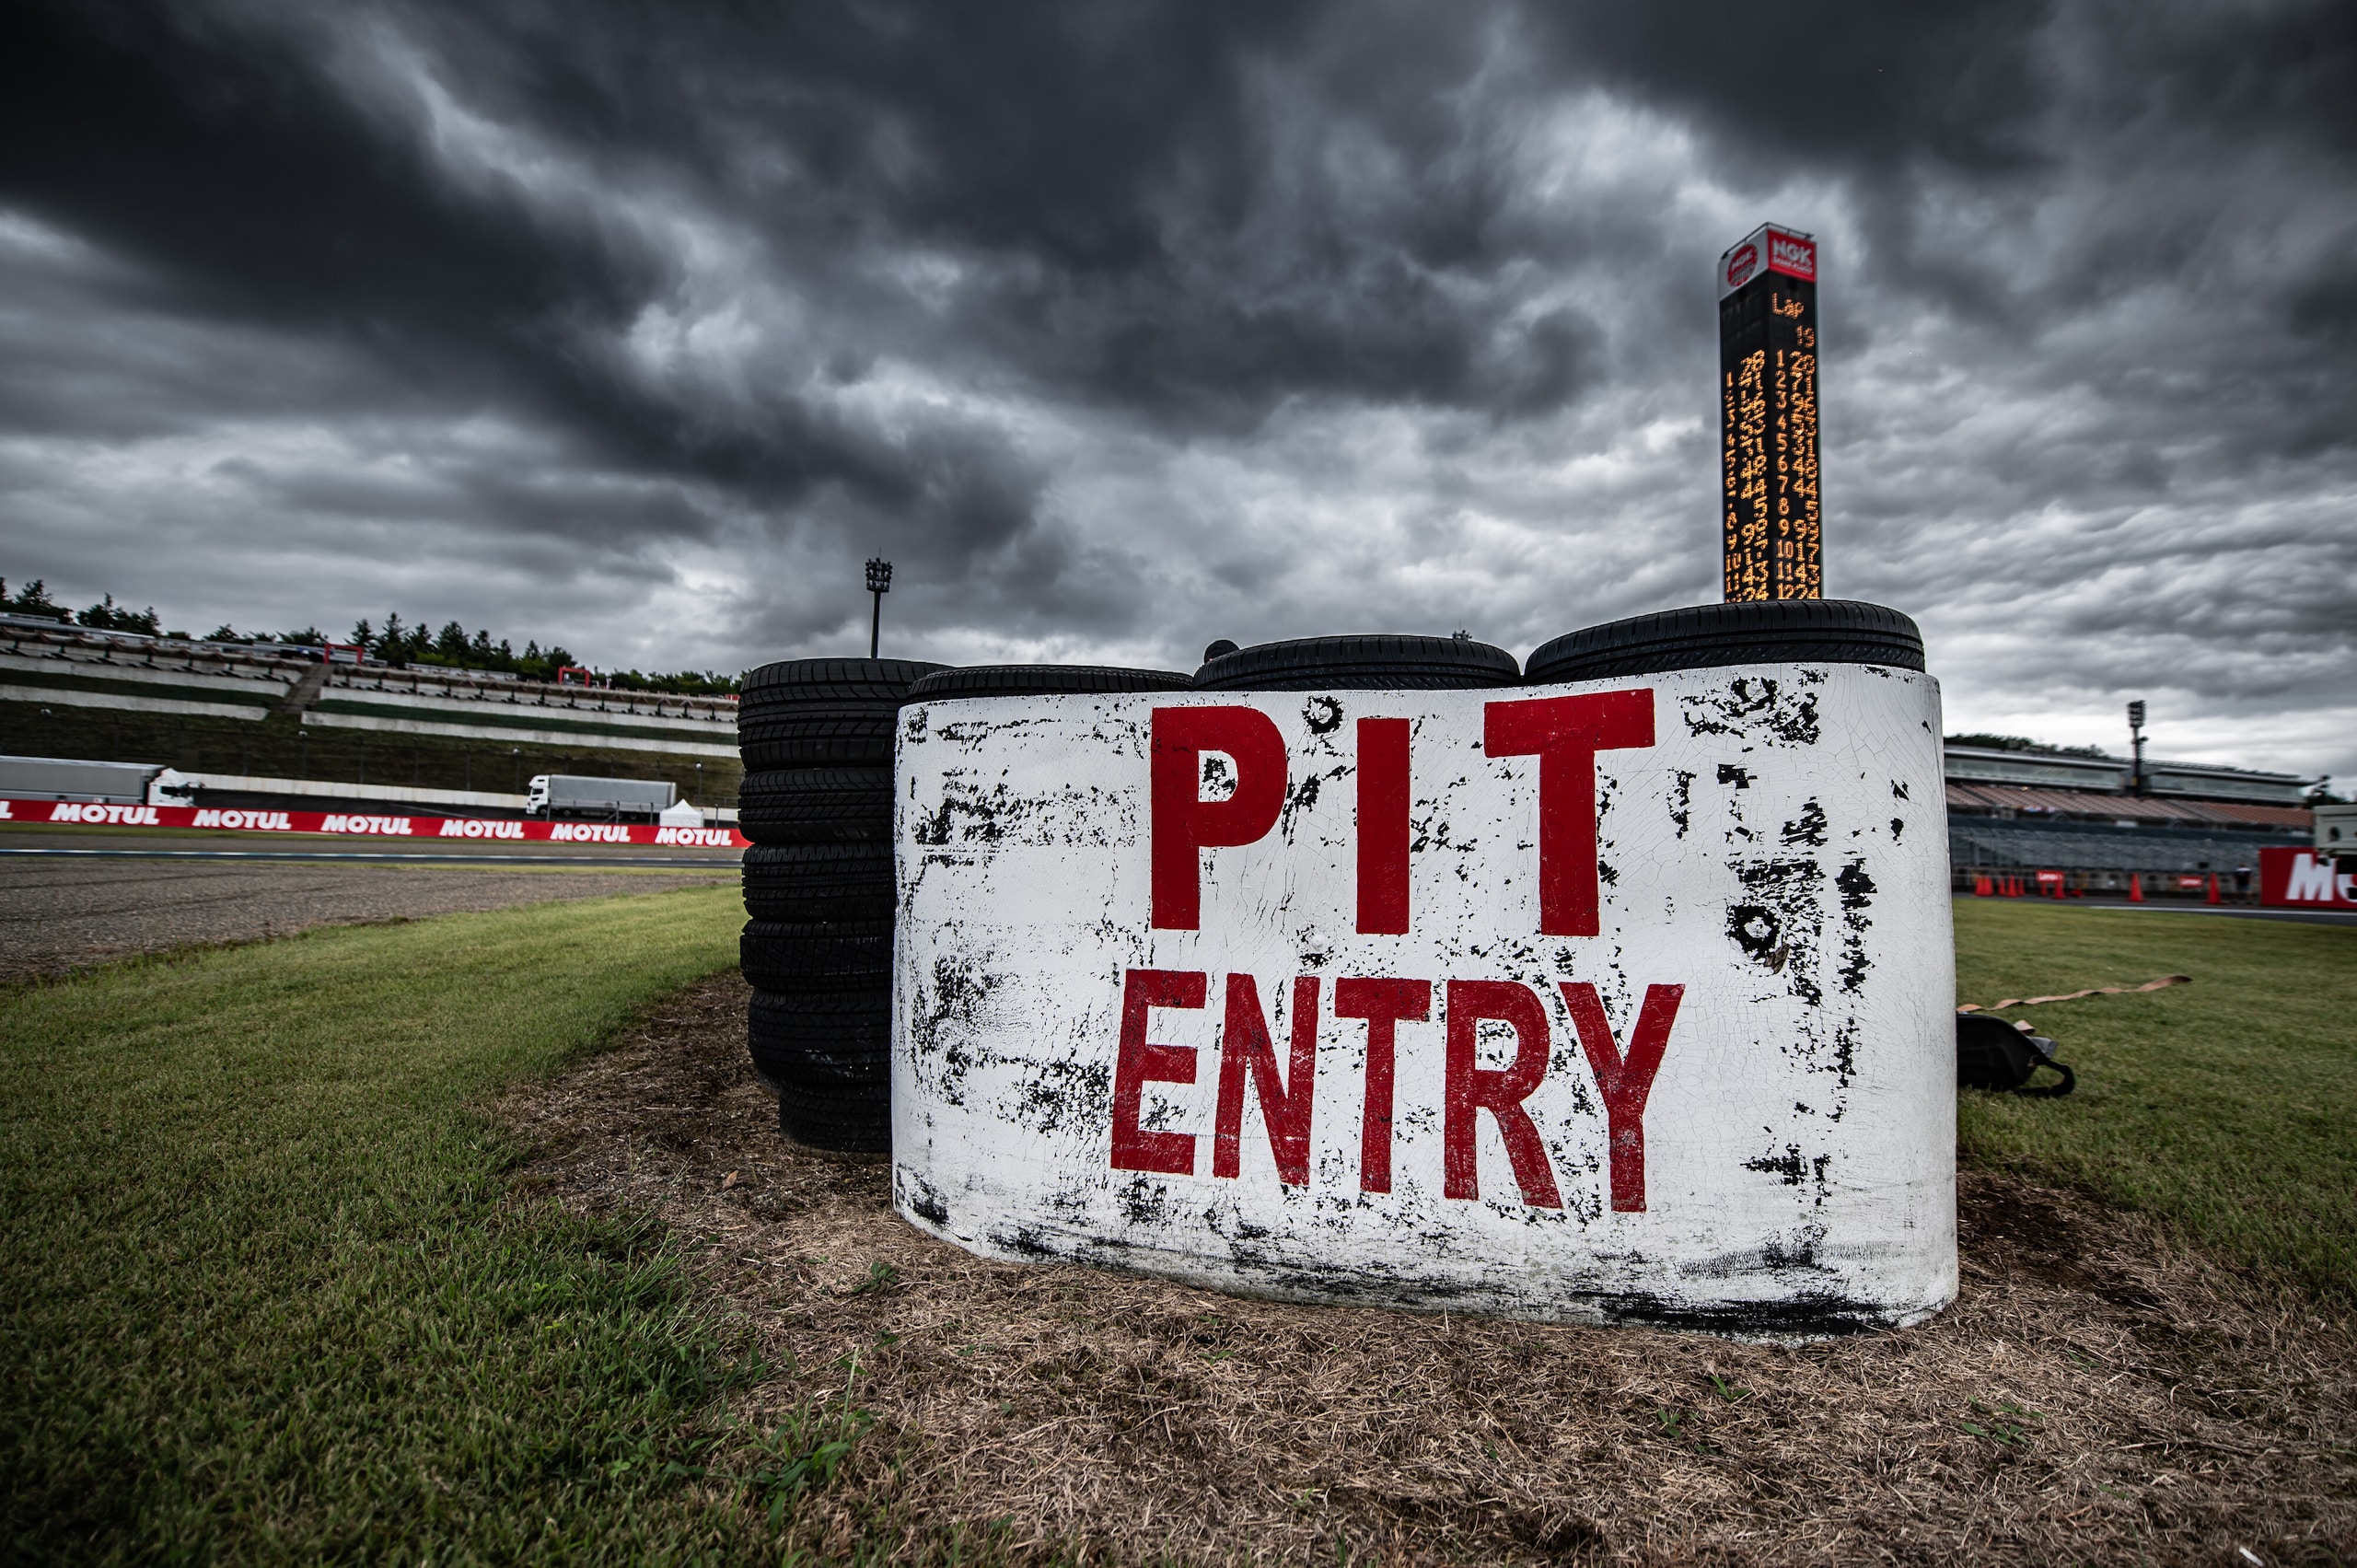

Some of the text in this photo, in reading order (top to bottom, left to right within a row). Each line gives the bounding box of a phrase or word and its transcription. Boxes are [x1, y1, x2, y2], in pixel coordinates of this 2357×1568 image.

[1772, 238, 1813, 266] NGK
[1771, 292, 1805, 319] Lap
[1776, 349, 1784, 368] 1
[1775, 370, 1786, 389] 2
[1775, 390, 1787, 410] 3
[1776, 413, 1787, 431] 4
[1776, 433, 1787, 452] 5
[1776, 455, 1788, 473] 6
[1740, 478, 1768, 499] 44
[1776, 475, 1818, 501] 7 44
[1753, 495, 1768, 518] 5
[1778, 497, 1790, 516] 8
[1778, 518, 1790, 537] 9
[1776, 540, 1820, 563] 10 17
[1776, 561, 1820, 586] 11 43
[1776, 583, 1794, 600] 12
[49, 803, 160, 825] MOTUL
[192, 809, 292, 830] MOTUL
[1151, 689, 1655, 936] PIT
[320, 815, 412, 835] MOTUL
[439, 819, 525, 839] MOTUL
[550, 823, 632, 842] MOTUL
[655, 827, 733, 845] MOTUL
[1111, 970, 1685, 1213] ENTRY
